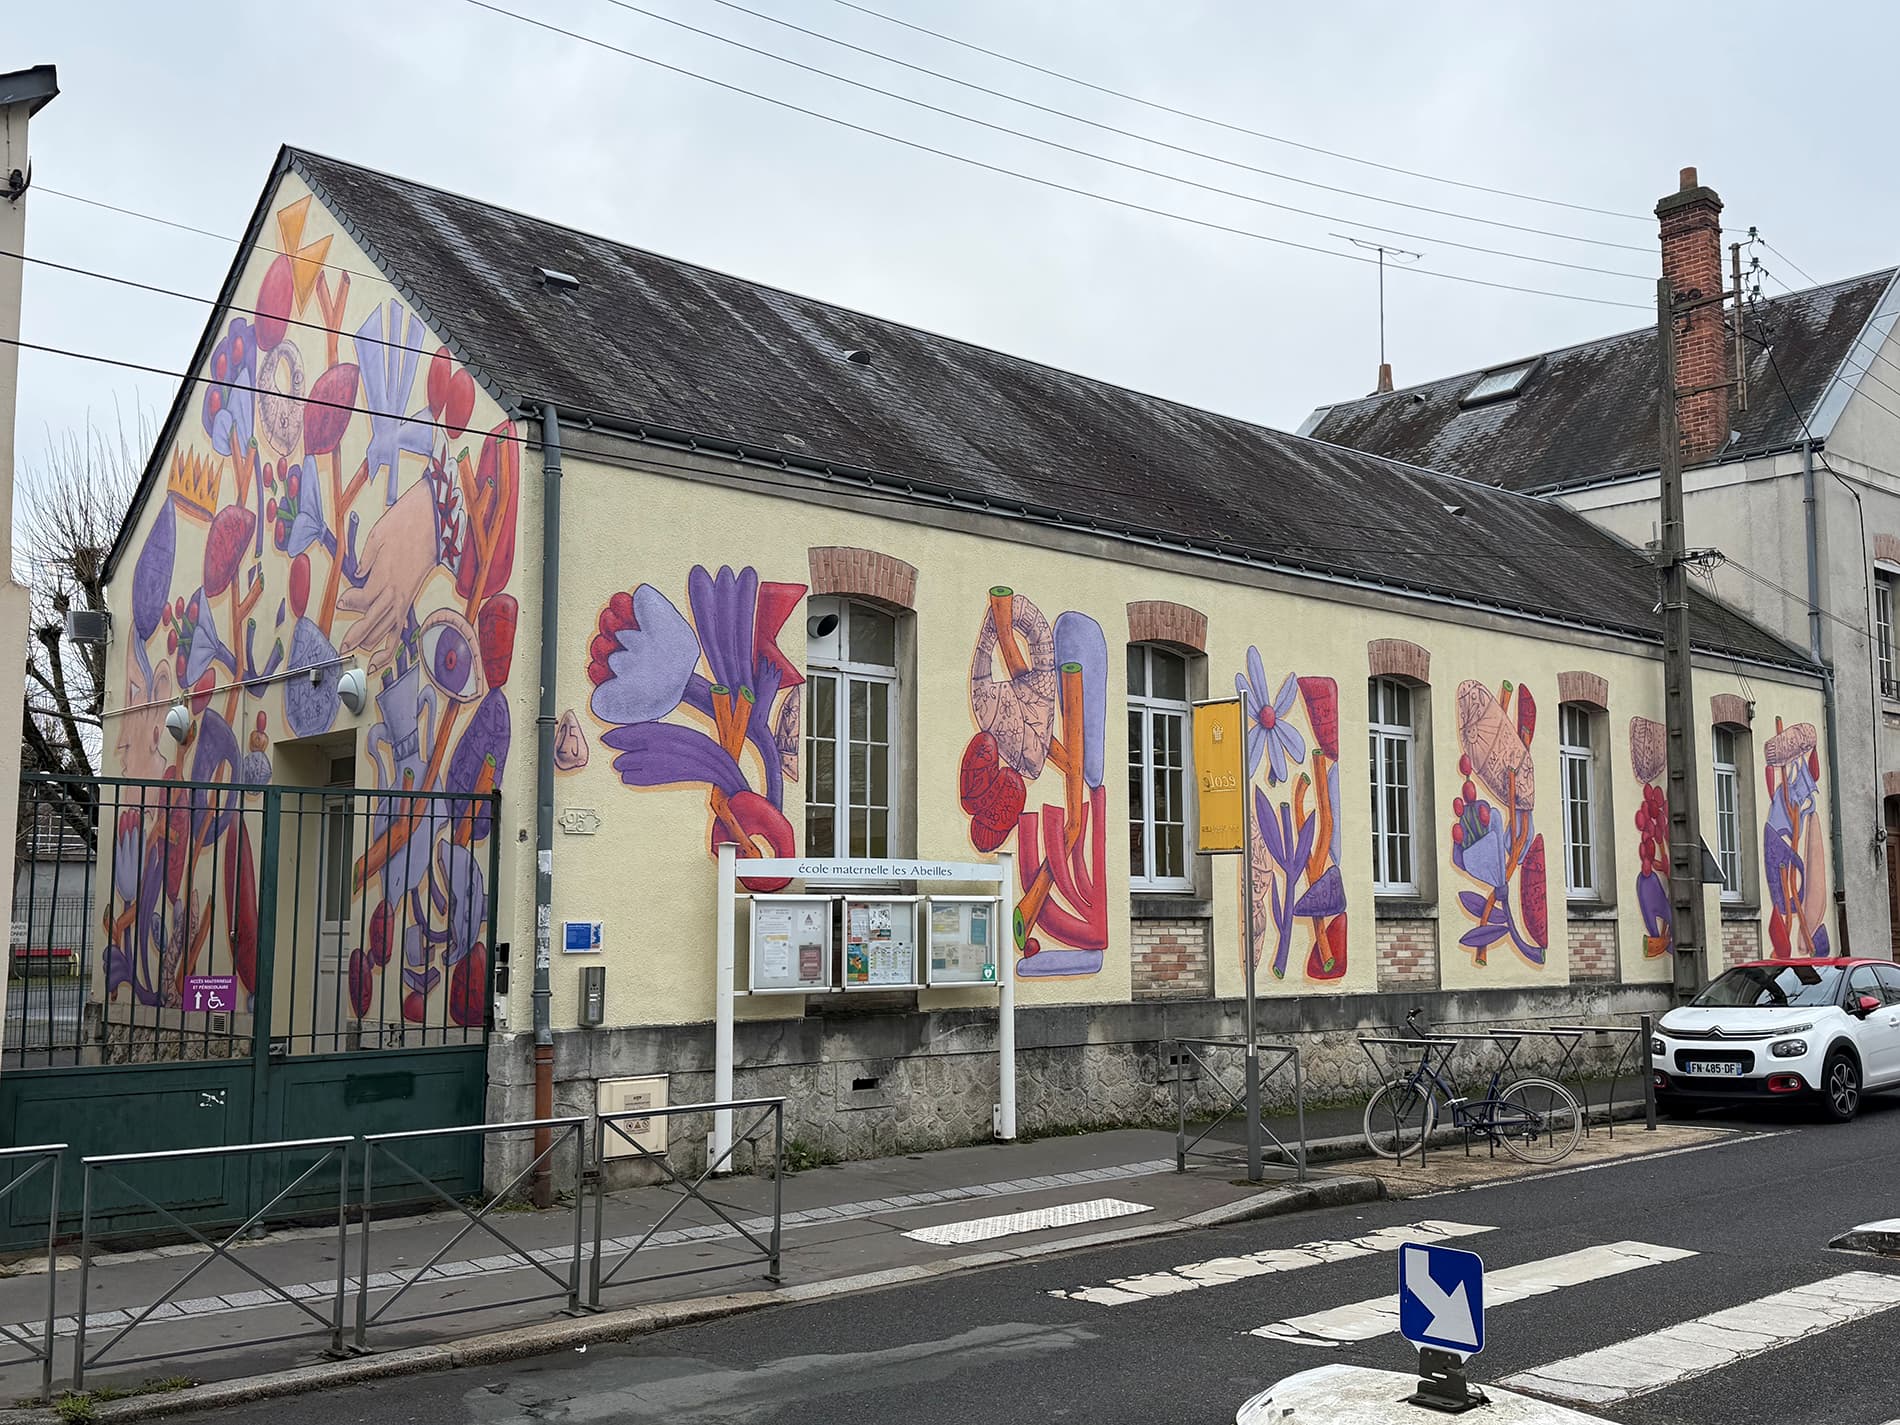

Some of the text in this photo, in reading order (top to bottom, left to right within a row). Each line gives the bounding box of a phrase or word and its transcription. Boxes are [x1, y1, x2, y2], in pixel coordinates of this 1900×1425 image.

[557, 723, 579, 758] 25
[798, 862, 953, 877] école maternelle les Abeilles
[1691, 1063, 1735, 1073] FN-485-DF
